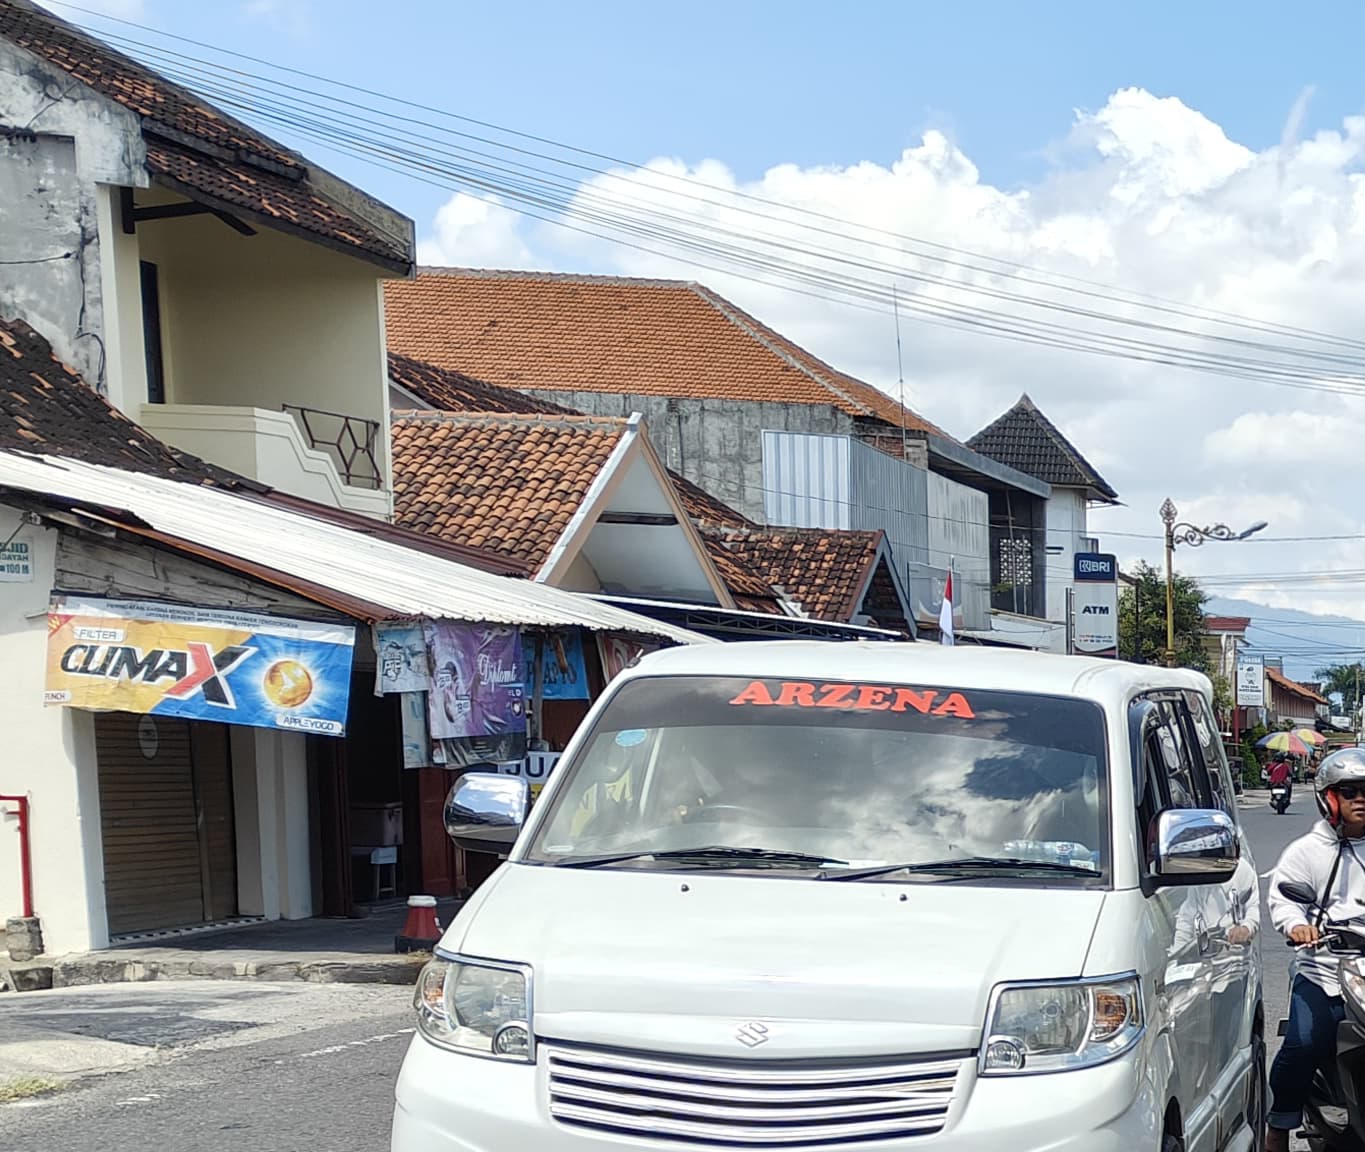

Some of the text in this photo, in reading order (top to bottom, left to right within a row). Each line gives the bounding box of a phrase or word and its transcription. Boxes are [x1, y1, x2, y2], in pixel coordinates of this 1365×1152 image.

[1091, 560, 1111, 573] BRI
[1082, 606, 1110, 615] ATM
[79, 627, 118, 640] FILTER
[60, 642, 258, 709] CLIMAX
[728, 681, 976, 719] ARZENA
